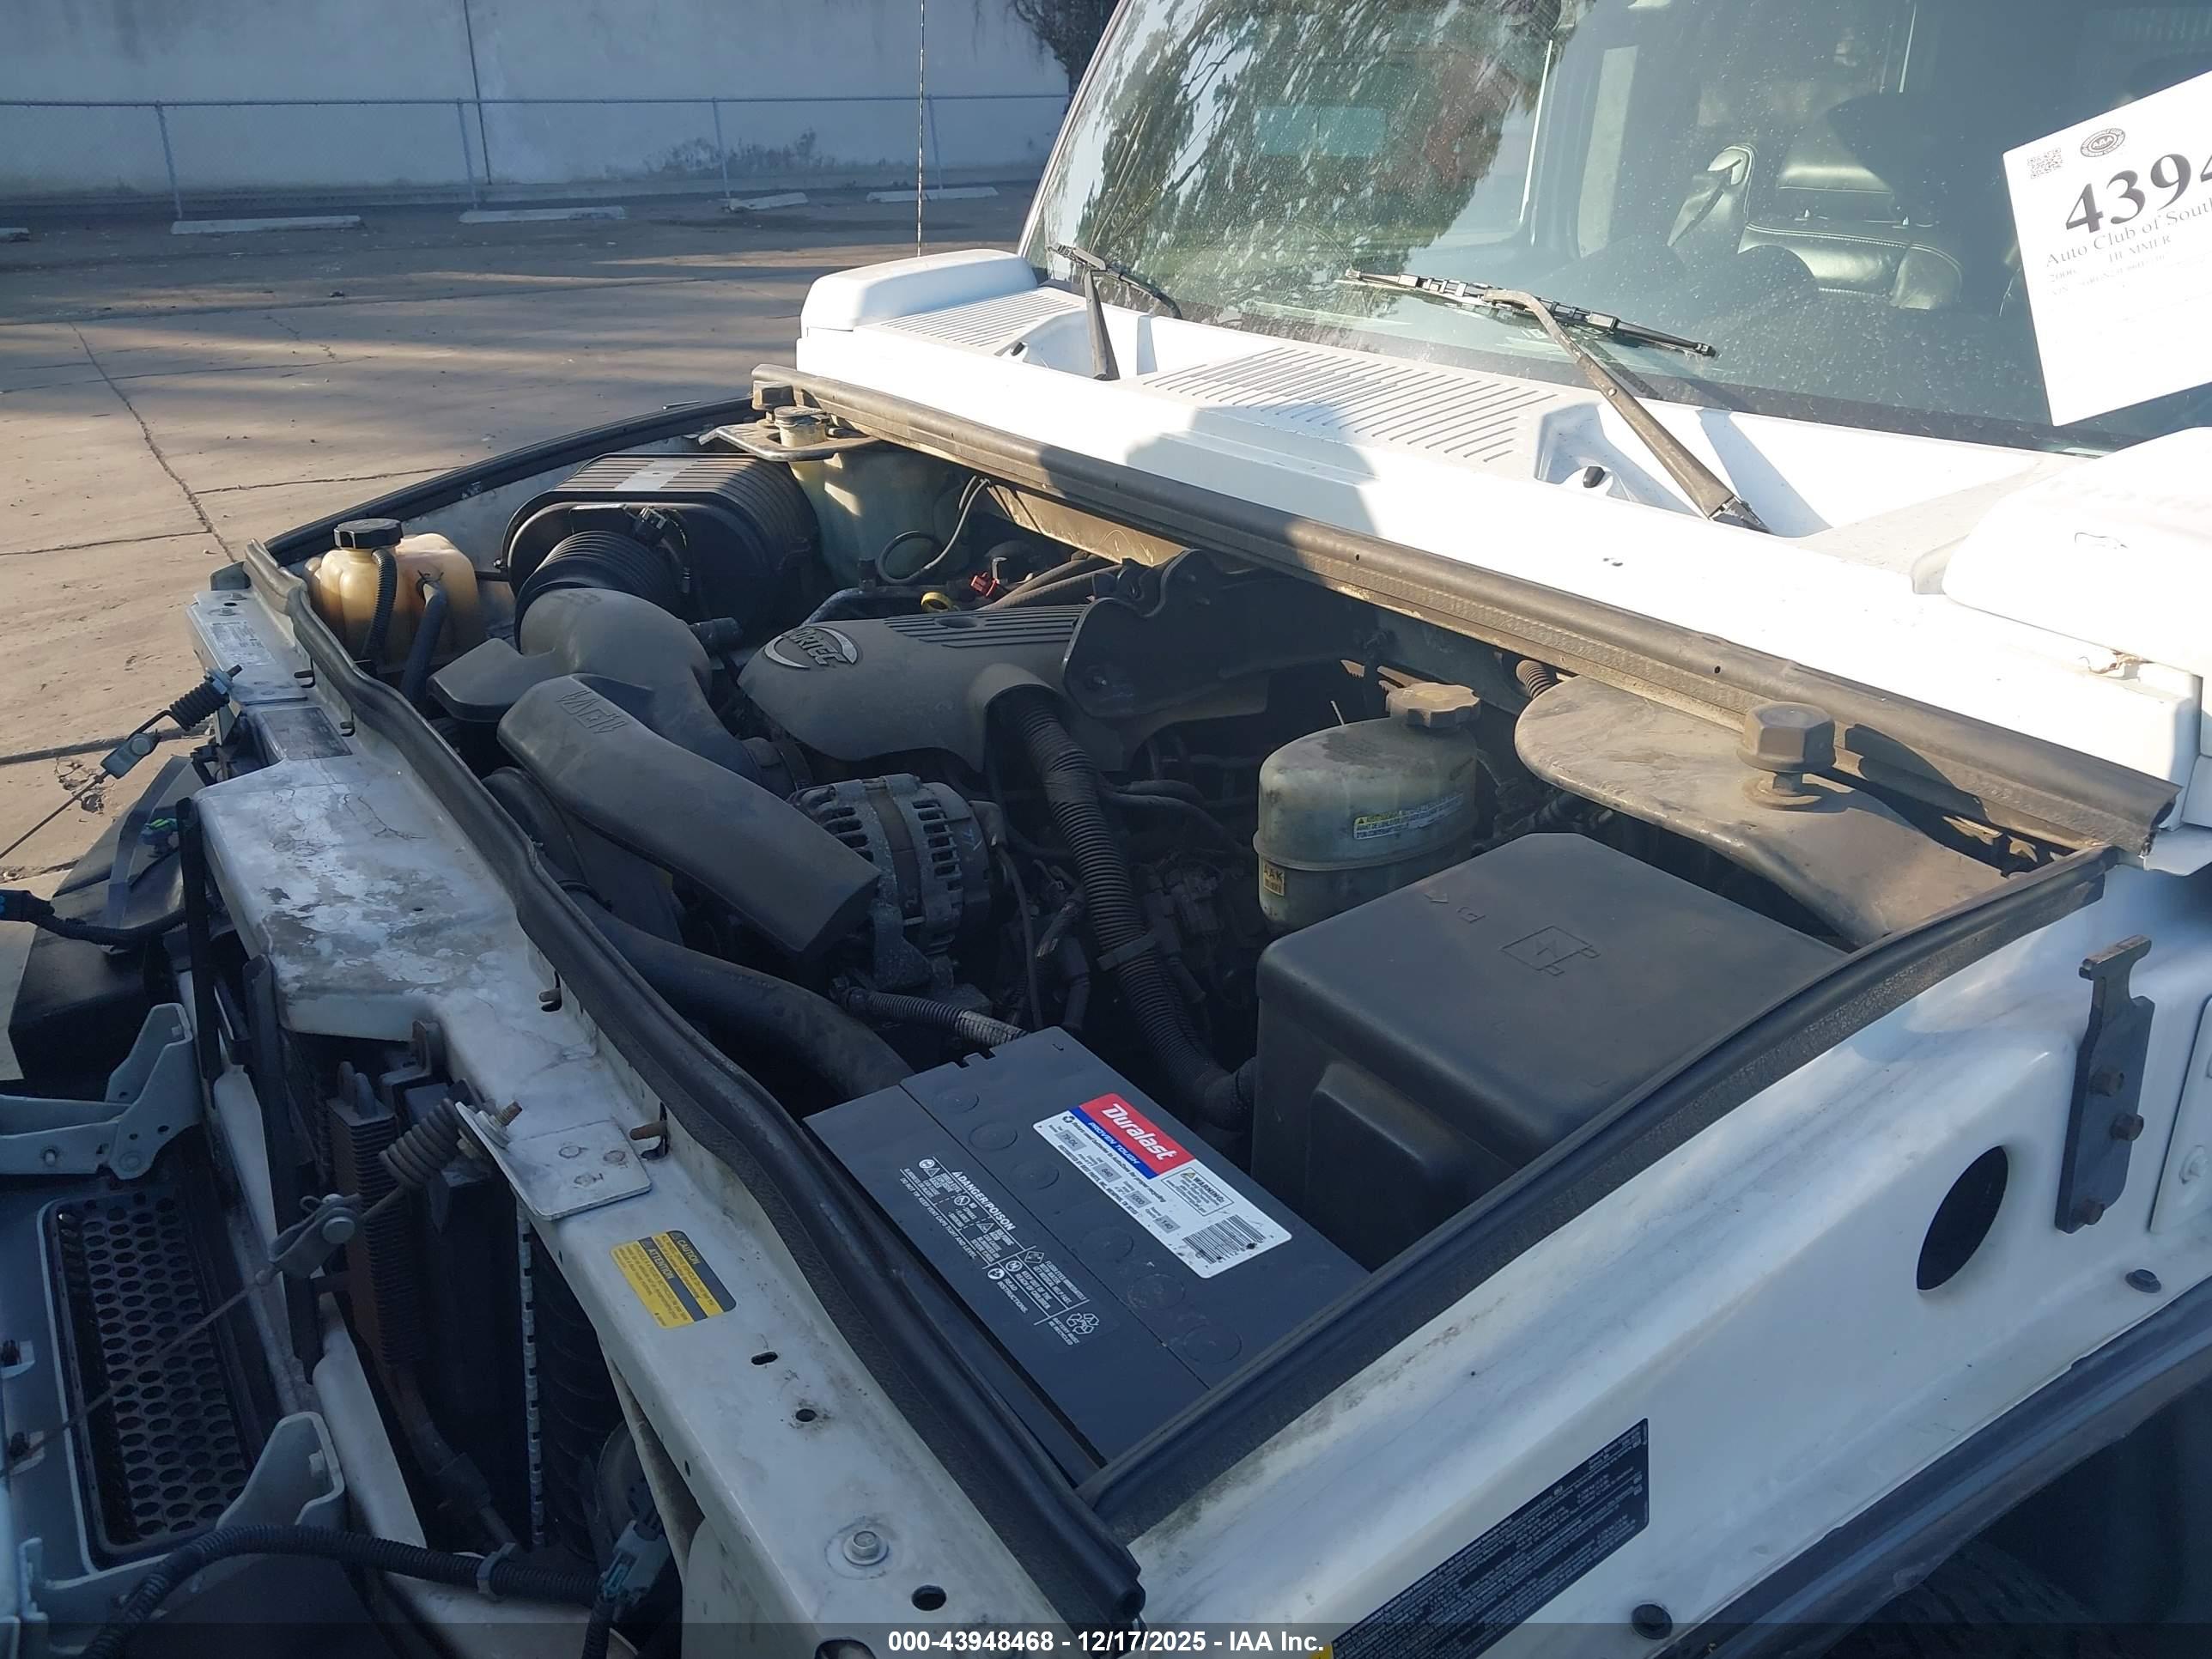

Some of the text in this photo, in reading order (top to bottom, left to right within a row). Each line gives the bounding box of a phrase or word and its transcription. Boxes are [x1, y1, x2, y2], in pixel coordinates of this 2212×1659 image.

[2047, 245, 2087, 267] Auto
[2094, 227, 2136, 250] Club
[2142, 215, 2162, 233] of
[1086, 1121, 1117, 1145] PROVEN
[1113, 1144, 1140, 1164] TOUGH
[1098, 1103, 1179, 1161] Duralast
[956, 1175, 1016, 1231] DANGER/POISON
[1192, 1176, 1225, 1202] WARNING:
[1159, 1219, 1175, 1230] 140
[648, 1249, 675, 1279] ATTENTION
[677, 1239, 702, 1265] CAUTION
[1002, 1277, 1019, 1291] READ
